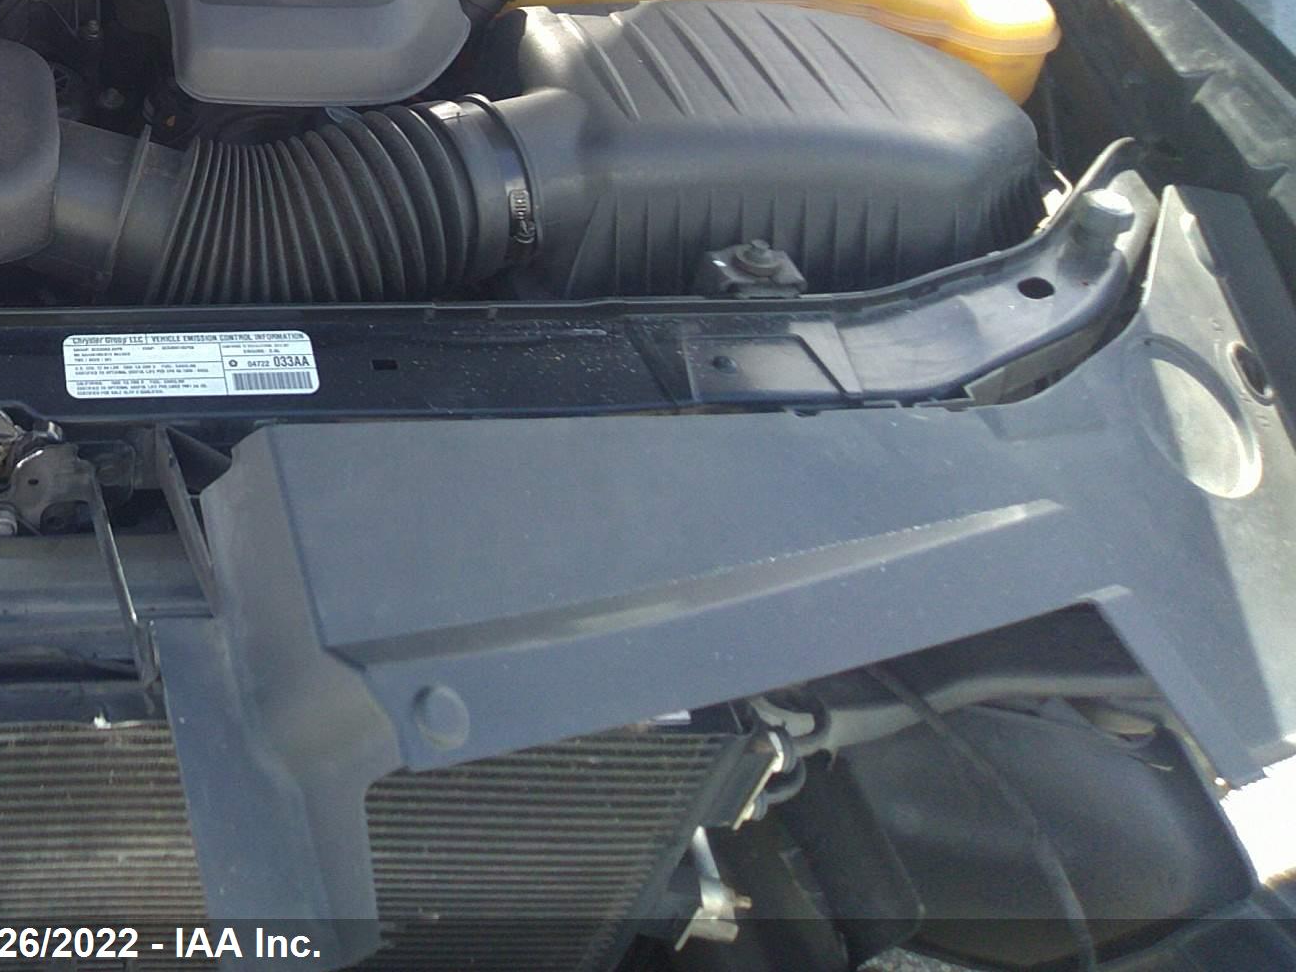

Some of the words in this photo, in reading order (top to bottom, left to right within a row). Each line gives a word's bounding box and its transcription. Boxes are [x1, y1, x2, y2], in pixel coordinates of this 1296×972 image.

[72, 336, 103, 345] Chrysler
[104, 336, 128, 345] Group
[129, 335, 144, 343] LLC
[151, 335, 181, 343] VEHICLE
[183, 334, 218, 342] EMISSION
[254, 332, 305, 340] INFORMATION
[272, 355, 311, 367] 033AA
